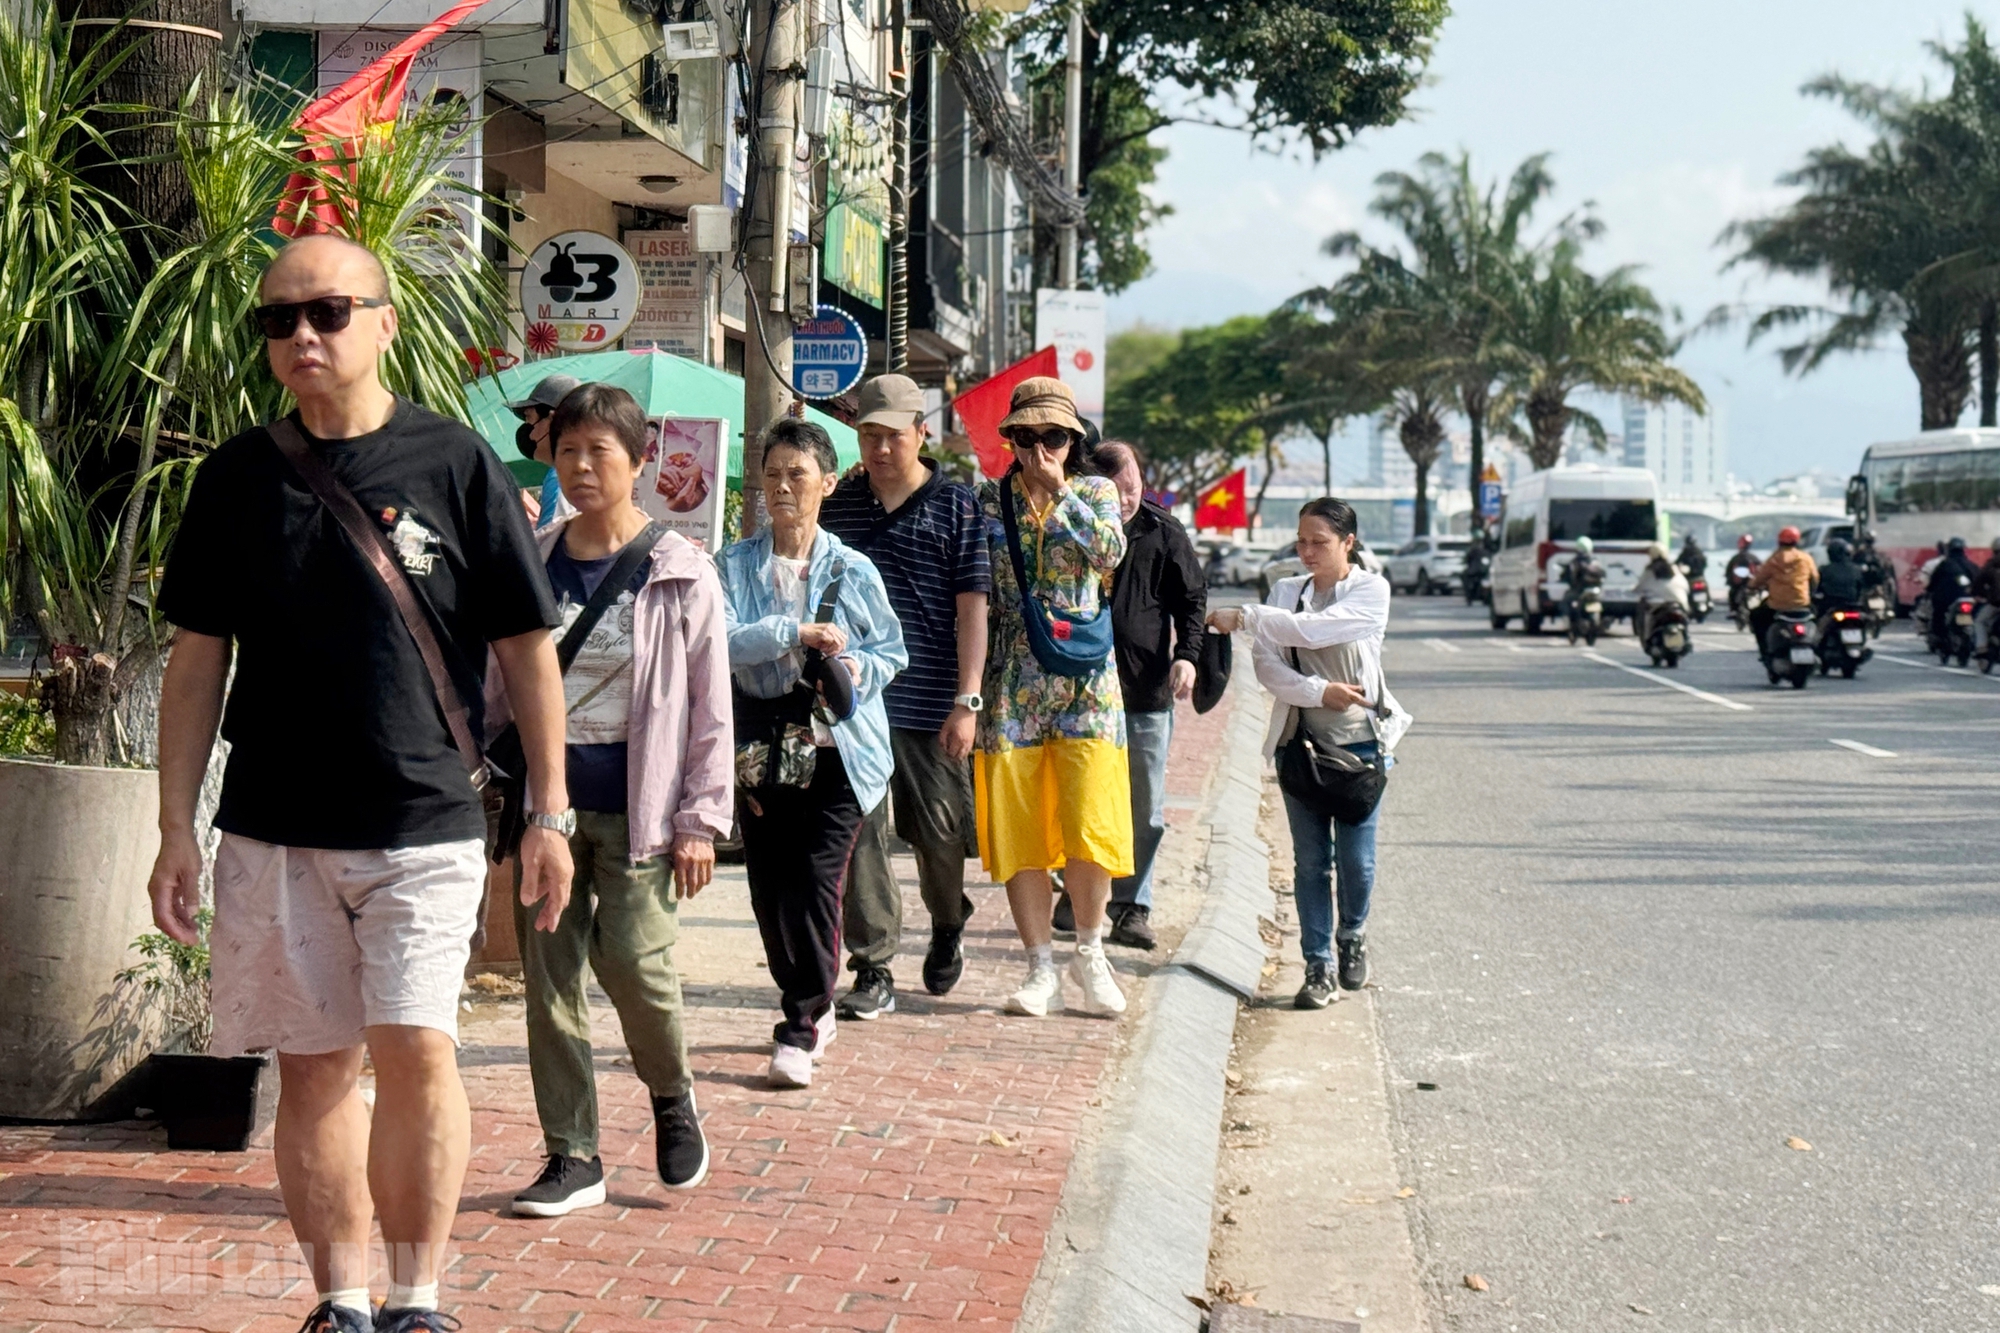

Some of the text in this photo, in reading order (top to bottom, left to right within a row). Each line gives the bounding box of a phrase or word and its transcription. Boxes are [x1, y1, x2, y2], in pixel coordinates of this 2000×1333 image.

[365, 41, 435, 54] DISCNT
[638, 240, 692, 256] LASER
[538, 304, 620, 319] MART
[795, 343, 855, 361] HARMACY
[805, 373, 834, 389] 약국
[1485, 486, 1499, 502] P
[585, 632, 629, 653] Style
